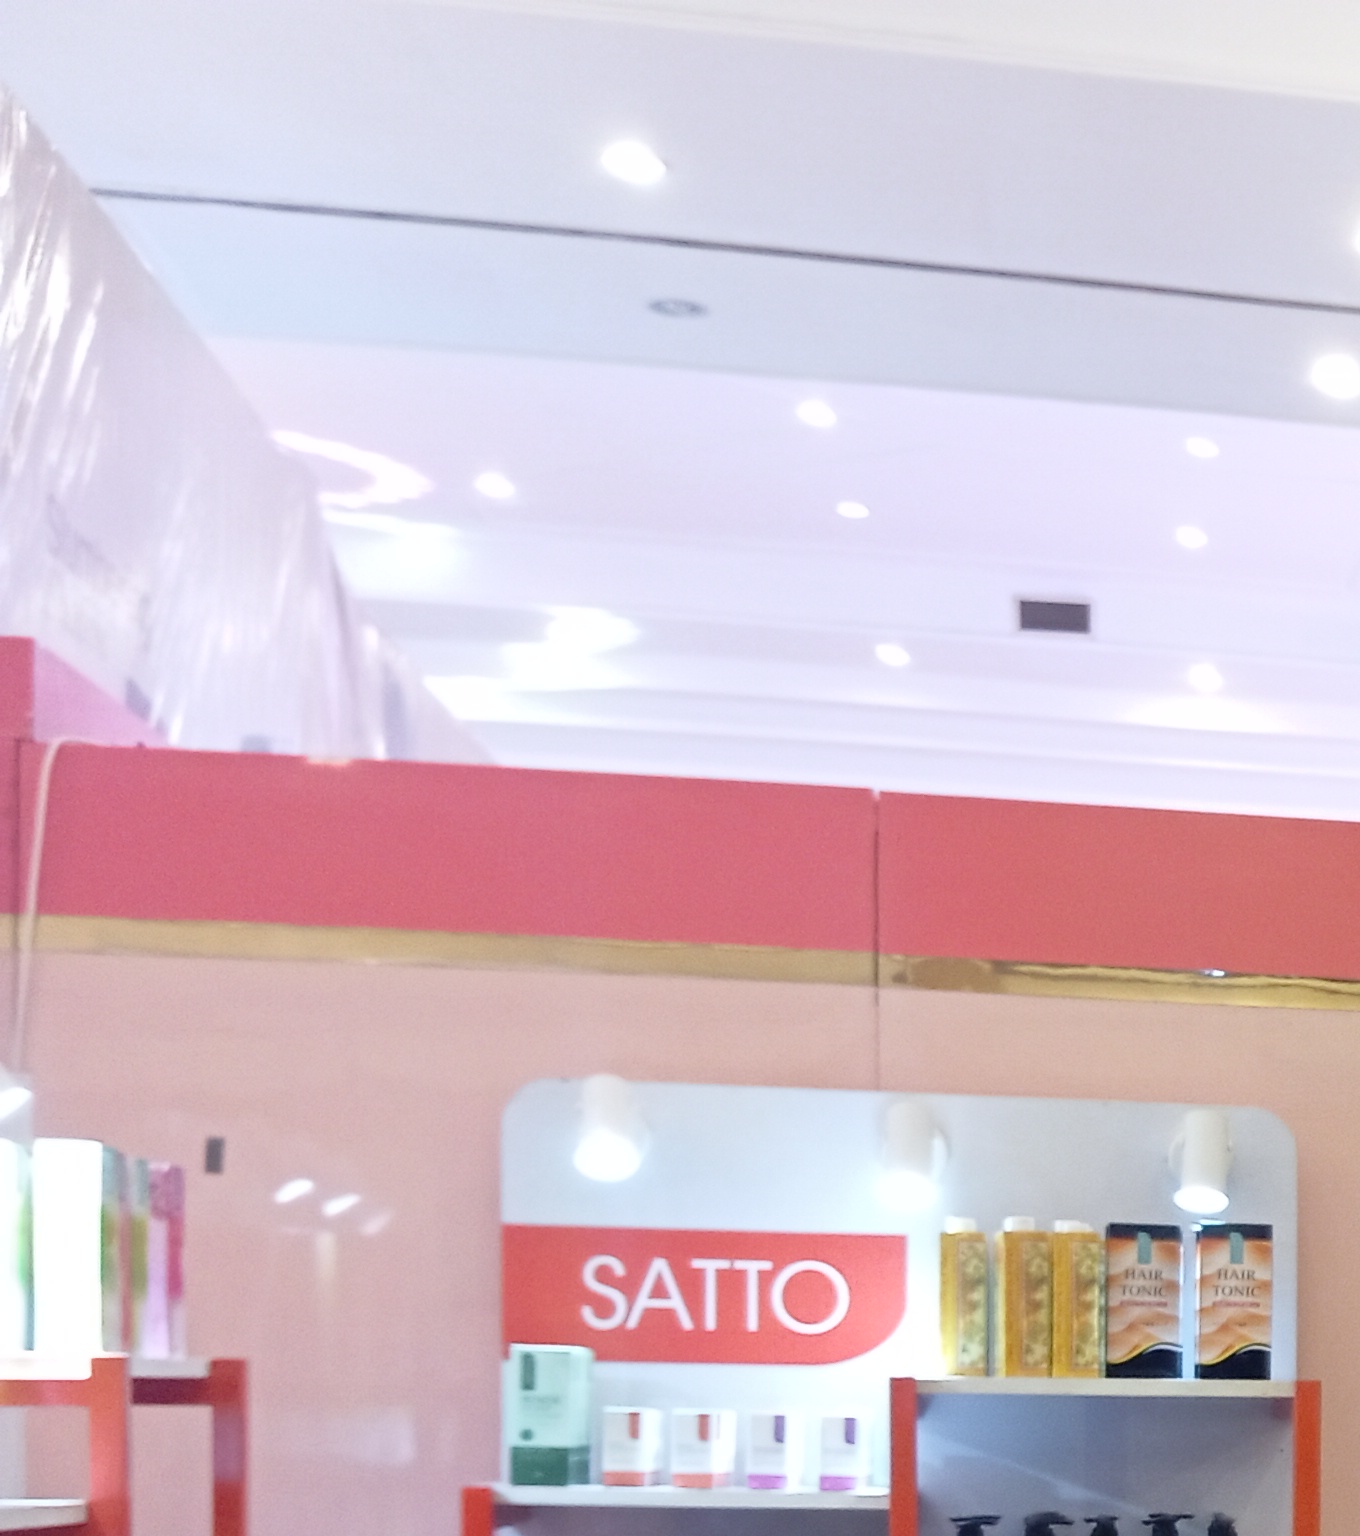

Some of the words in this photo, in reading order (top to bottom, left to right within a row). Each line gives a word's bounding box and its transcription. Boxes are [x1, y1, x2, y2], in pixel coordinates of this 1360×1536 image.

[1125, 1268, 1164, 1281] HAIR
[1217, 1268, 1256, 1281] HAIR
[580, 1254, 851, 1335] SATTO
[1121, 1285, 1167, 1297] TONIC
[1213, 1285, 1261, 1297] TONIC
